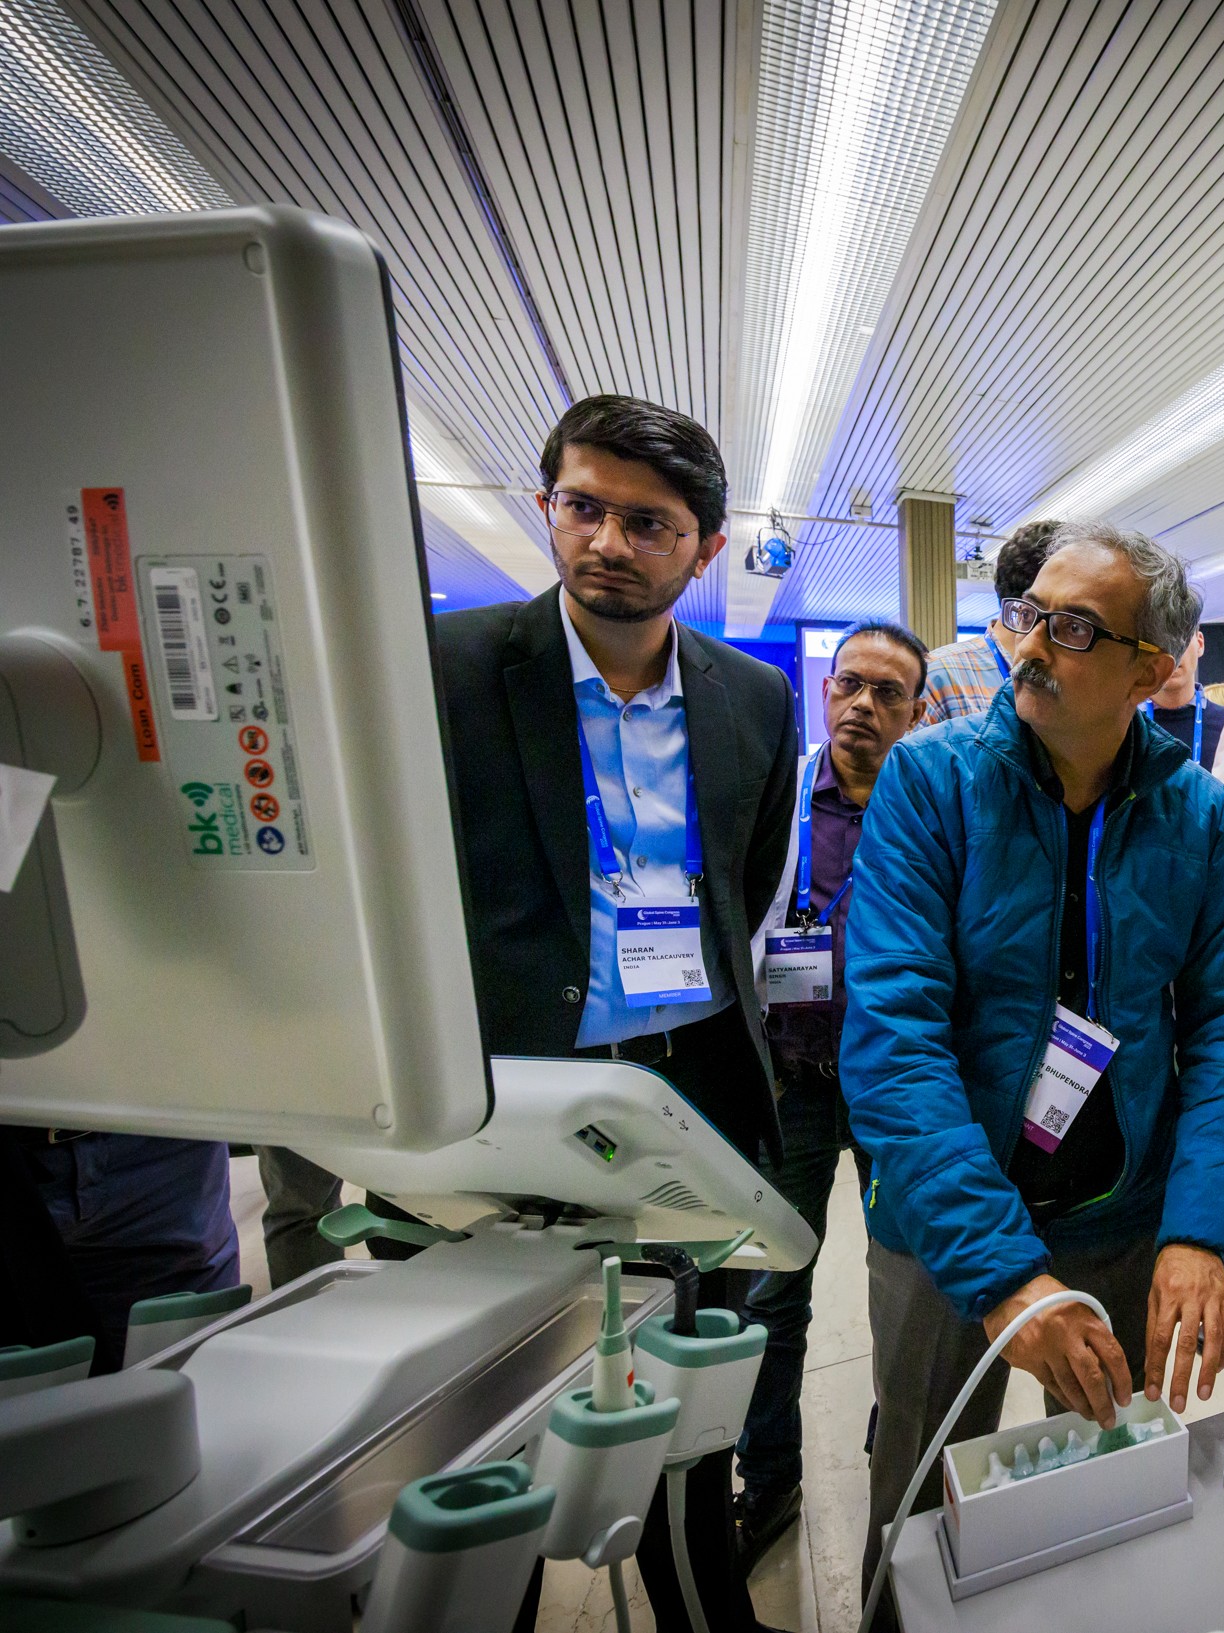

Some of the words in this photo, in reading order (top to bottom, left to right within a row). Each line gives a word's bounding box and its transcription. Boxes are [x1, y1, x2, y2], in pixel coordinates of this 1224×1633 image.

[131, 664, 144, 699] Com
[138, 709, 154, 748] Loan
[188, 813, 224, 855] bk
[215, 782, 244, 855] medical
[648, 953, 694, 961] TALACAUVERY
[1045, 1065, 1090, 1097] BHUPENDRA
